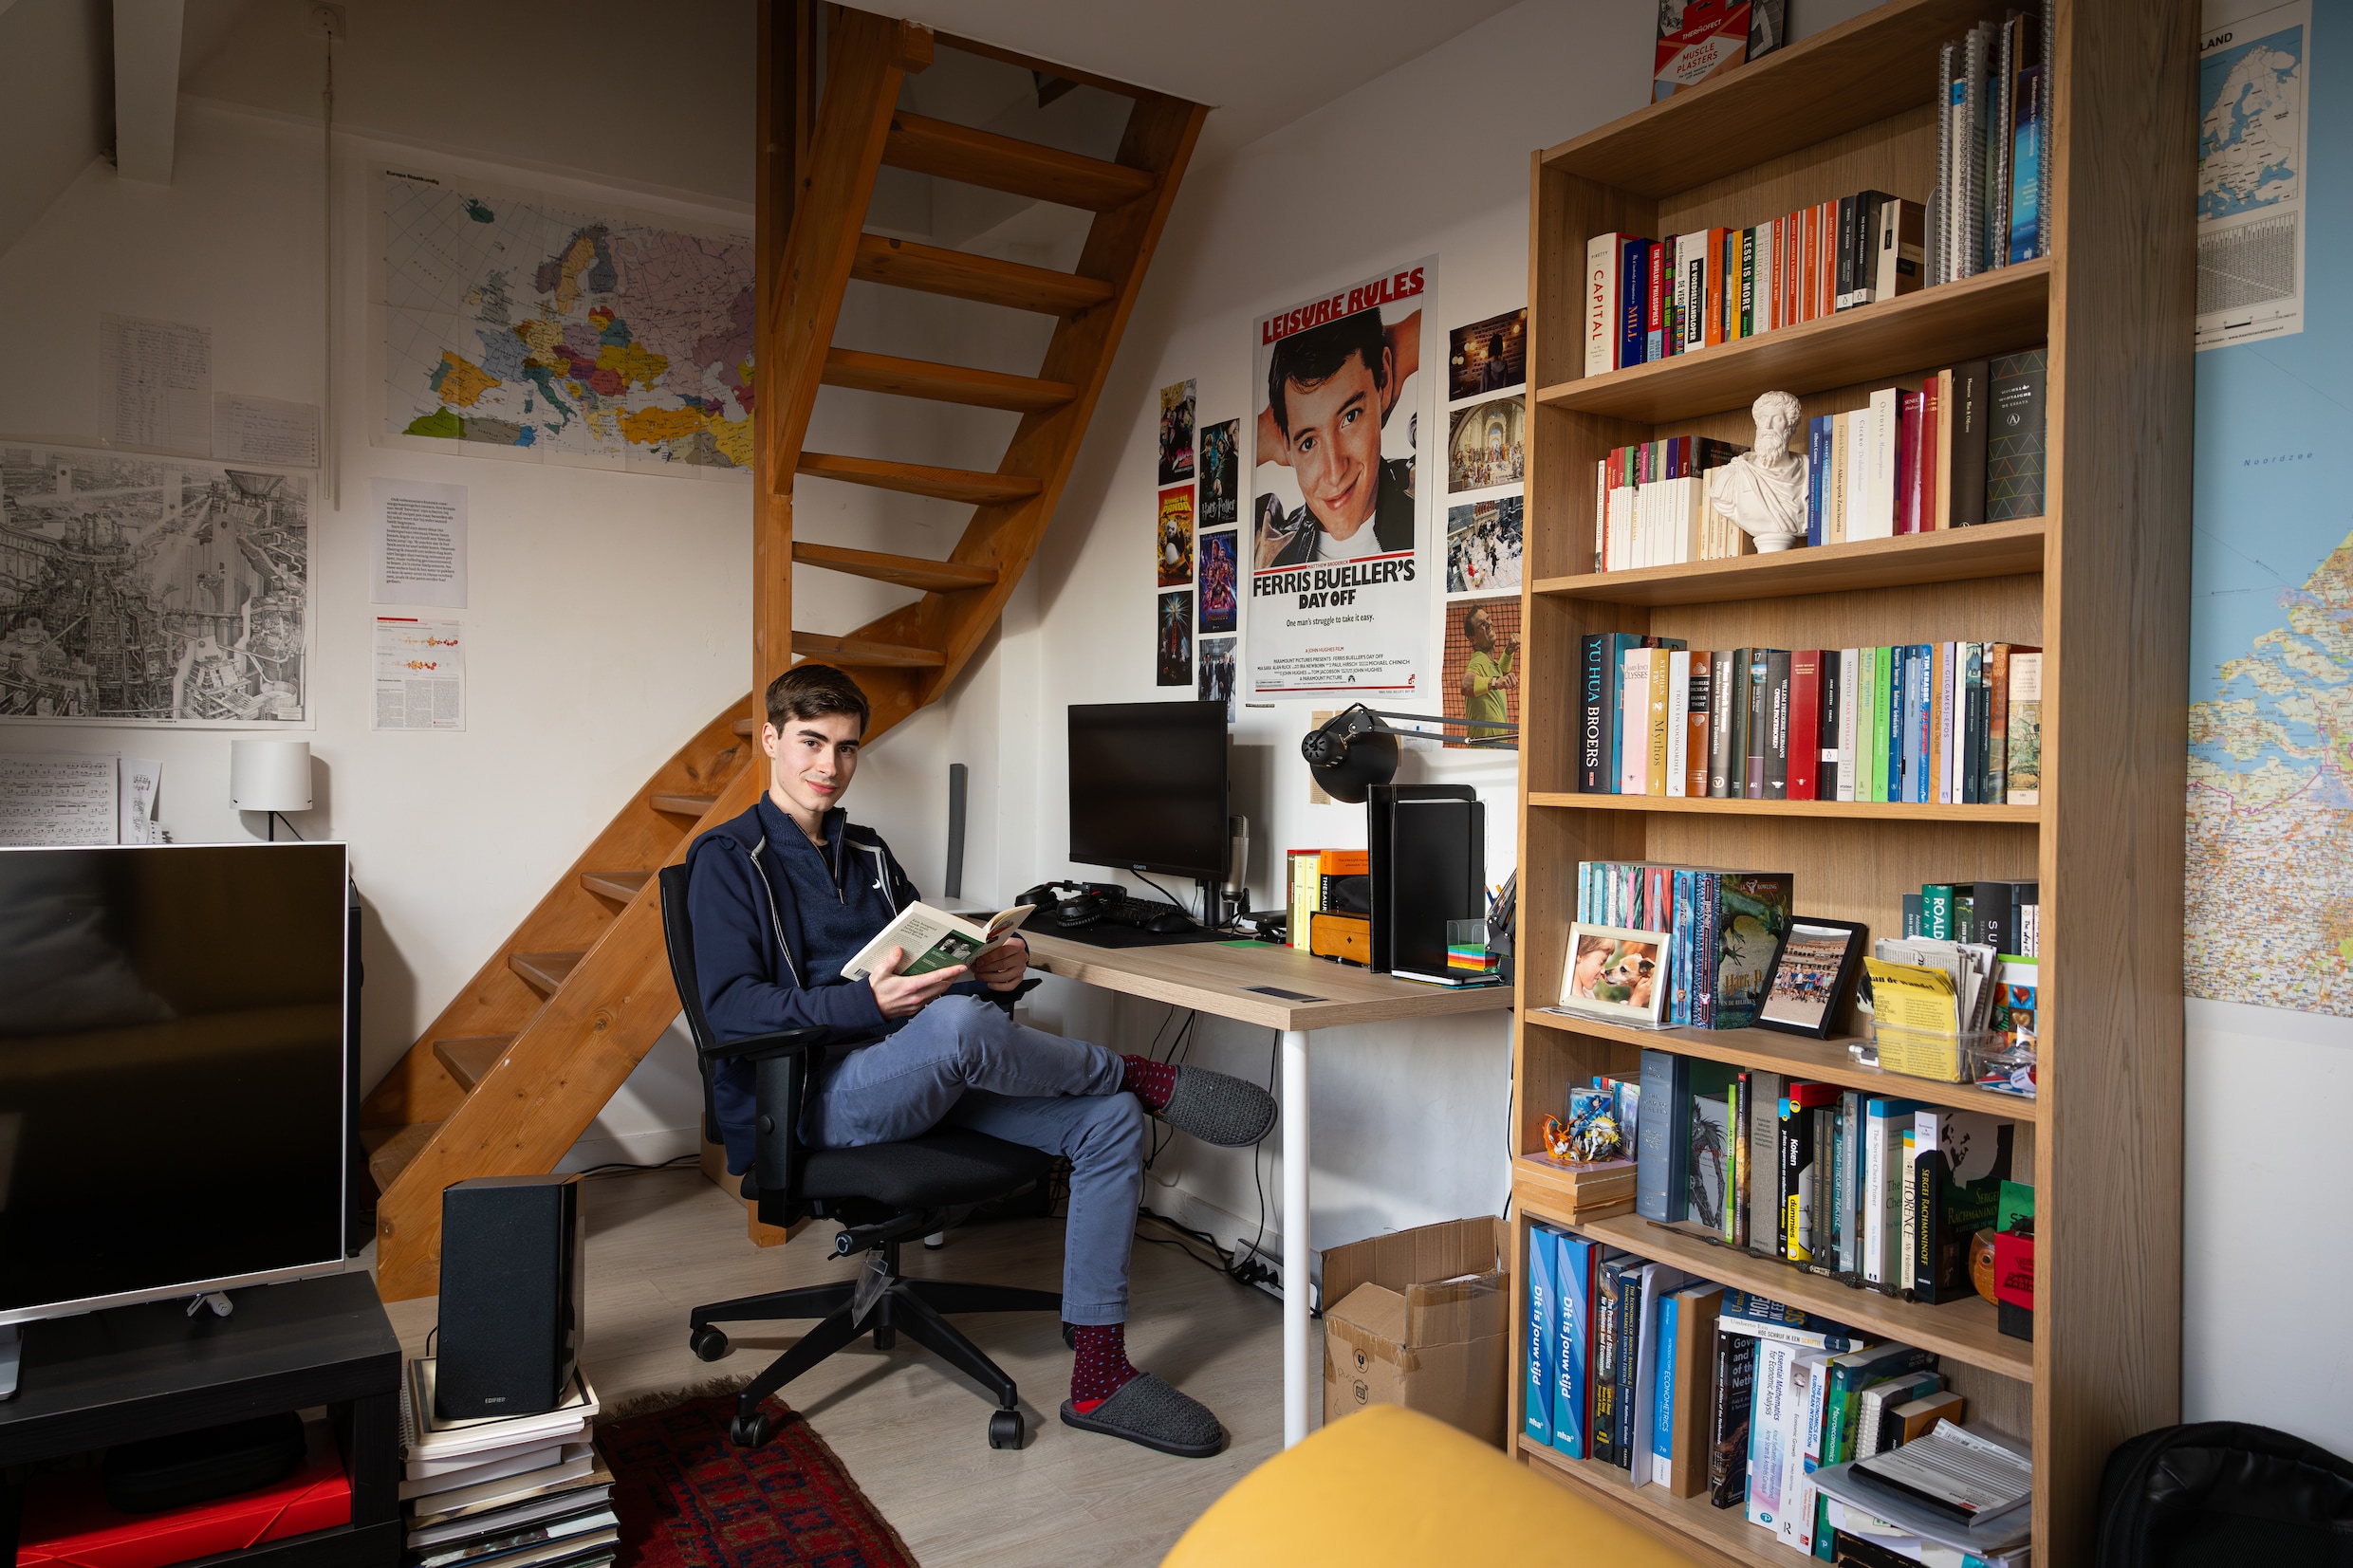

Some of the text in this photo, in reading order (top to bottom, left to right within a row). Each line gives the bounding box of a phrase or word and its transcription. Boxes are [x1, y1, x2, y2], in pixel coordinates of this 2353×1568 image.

[1682, 19, 1722, 40] THERMOFECT
[1677, 51, 1718, 74] PLASTERS
[1682, 43, 1714, 62] MUSCLE
[386, 171, 440, 185] Europa Staatkundig
[1691, 262, 1697, 271] DE
[1742, 237, 1751, 311] LESS IS MORE
[1263, 267, 1424, 345] LEISURE RULES
[1592, 270, 1603, 341] CAPITAL
[1628, 305, 1638, 342] MILL
[2244, 452, 2313, 467] Noordzee
[1160, 502, 1192, 516] PANDA
[1253, 560, 1415, 597] FERRIS BUELLER'S
[1299, 589, 1356, 609] DAY OFF
[1297, 618, 1312, 626] man's
[1313, 616, 1334, 626] struggle
[1754, 653, 1761, 661] 17
[1624, 671, 1648, 679] ULYSSES
[1585, 639, 1602, 767] YU HUA BROERS
[1676, 712, 1680, 722] EN
[1652, 720, 1664, 766] Mythos
[1933, 897, 1945, 939] ROALD
[1789, 1138, 1798, 1166] Koken
[1903, 1179, 1915, 1238] FLORENCE
[1920, 1169, 1931, 1266] SERGEI RACHMANINOFF
[1531, 1285, 1543, 1385] Dit is jouw tijd
[1731, 1319, 1756, 1329] Umberto
[1560, 1296, 1573, 1398] Dit is jouw tijd
[1767, 1360, 1776, 1389] Economic
[1773, 1351, 1785, 1421] Essential Mathematics
[1661, 1371, 1671, 1432] ECONOMETRICS
[1764, 1390, 1774, 1415] Analysis
[1813, 1434, 1818, 1443] OF
[1829, 1406, 1841, 1463] Macroeconomics
